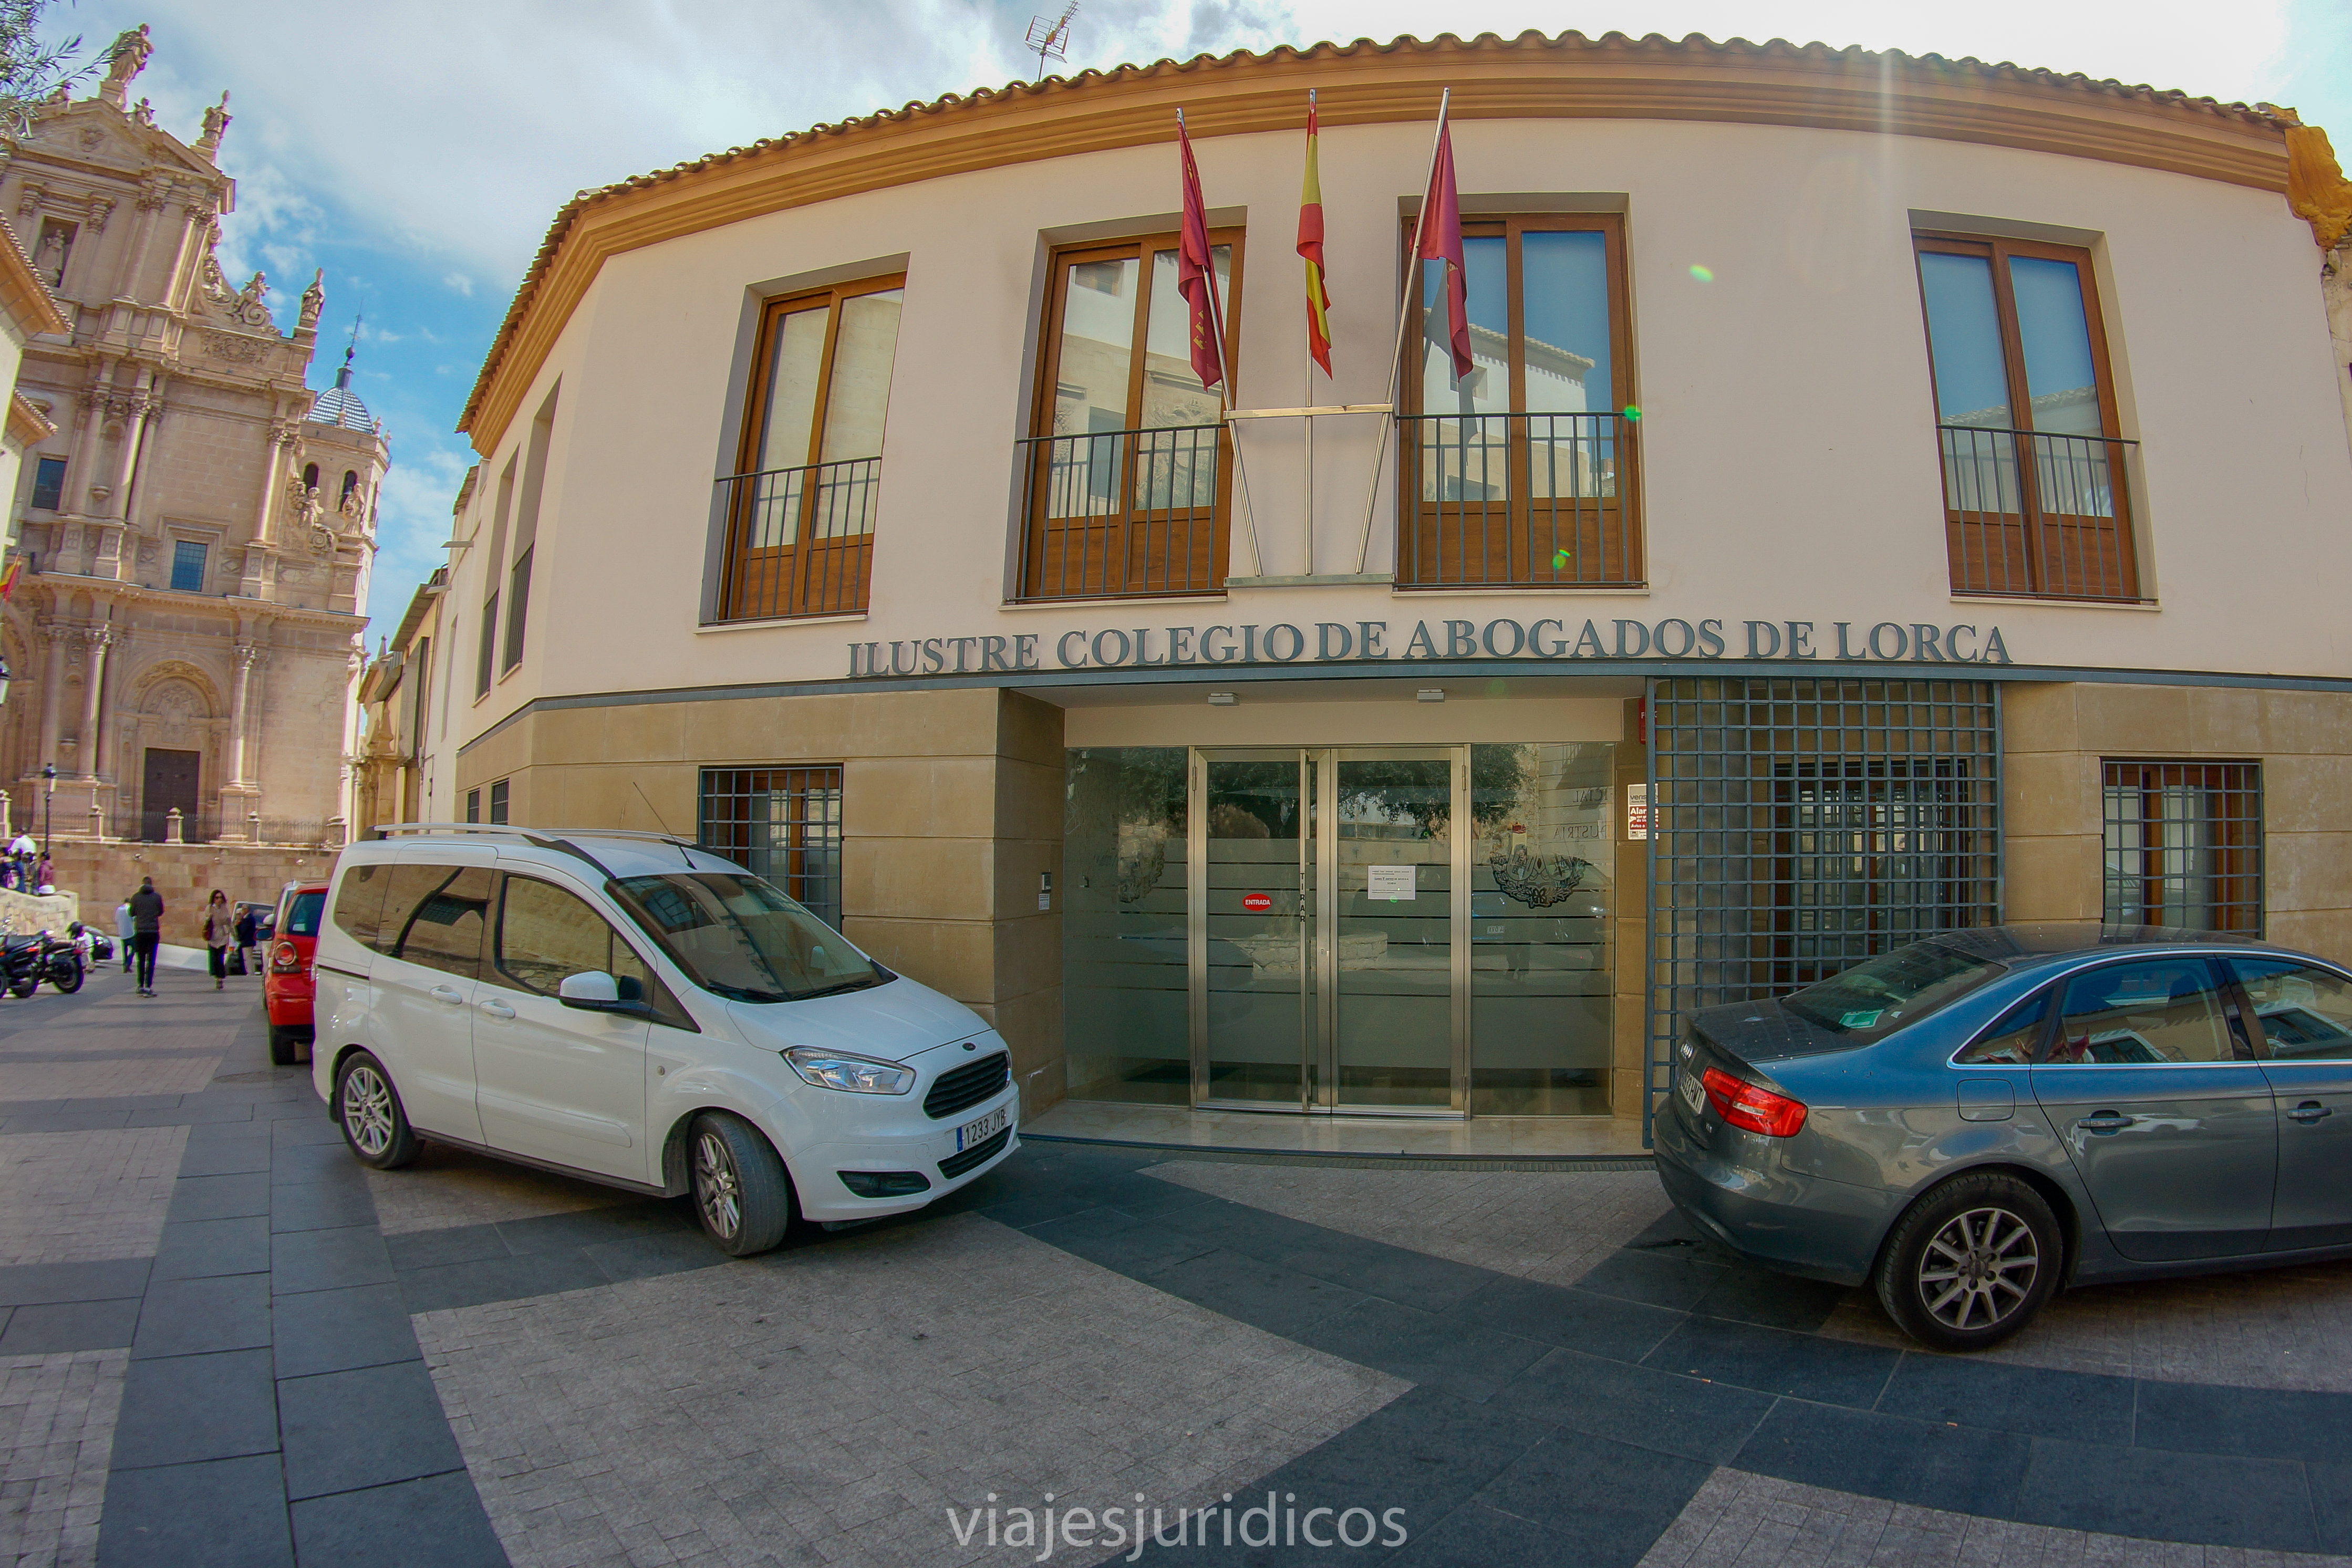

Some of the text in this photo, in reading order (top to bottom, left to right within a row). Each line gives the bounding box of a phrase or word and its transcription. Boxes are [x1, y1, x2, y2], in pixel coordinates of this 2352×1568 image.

[846, 618, 2014, 678] ILUSTRE COLEGIO DE ABOGADOS DE LORCA
[966, 1108, 1005, 1145] 1233 JYB
